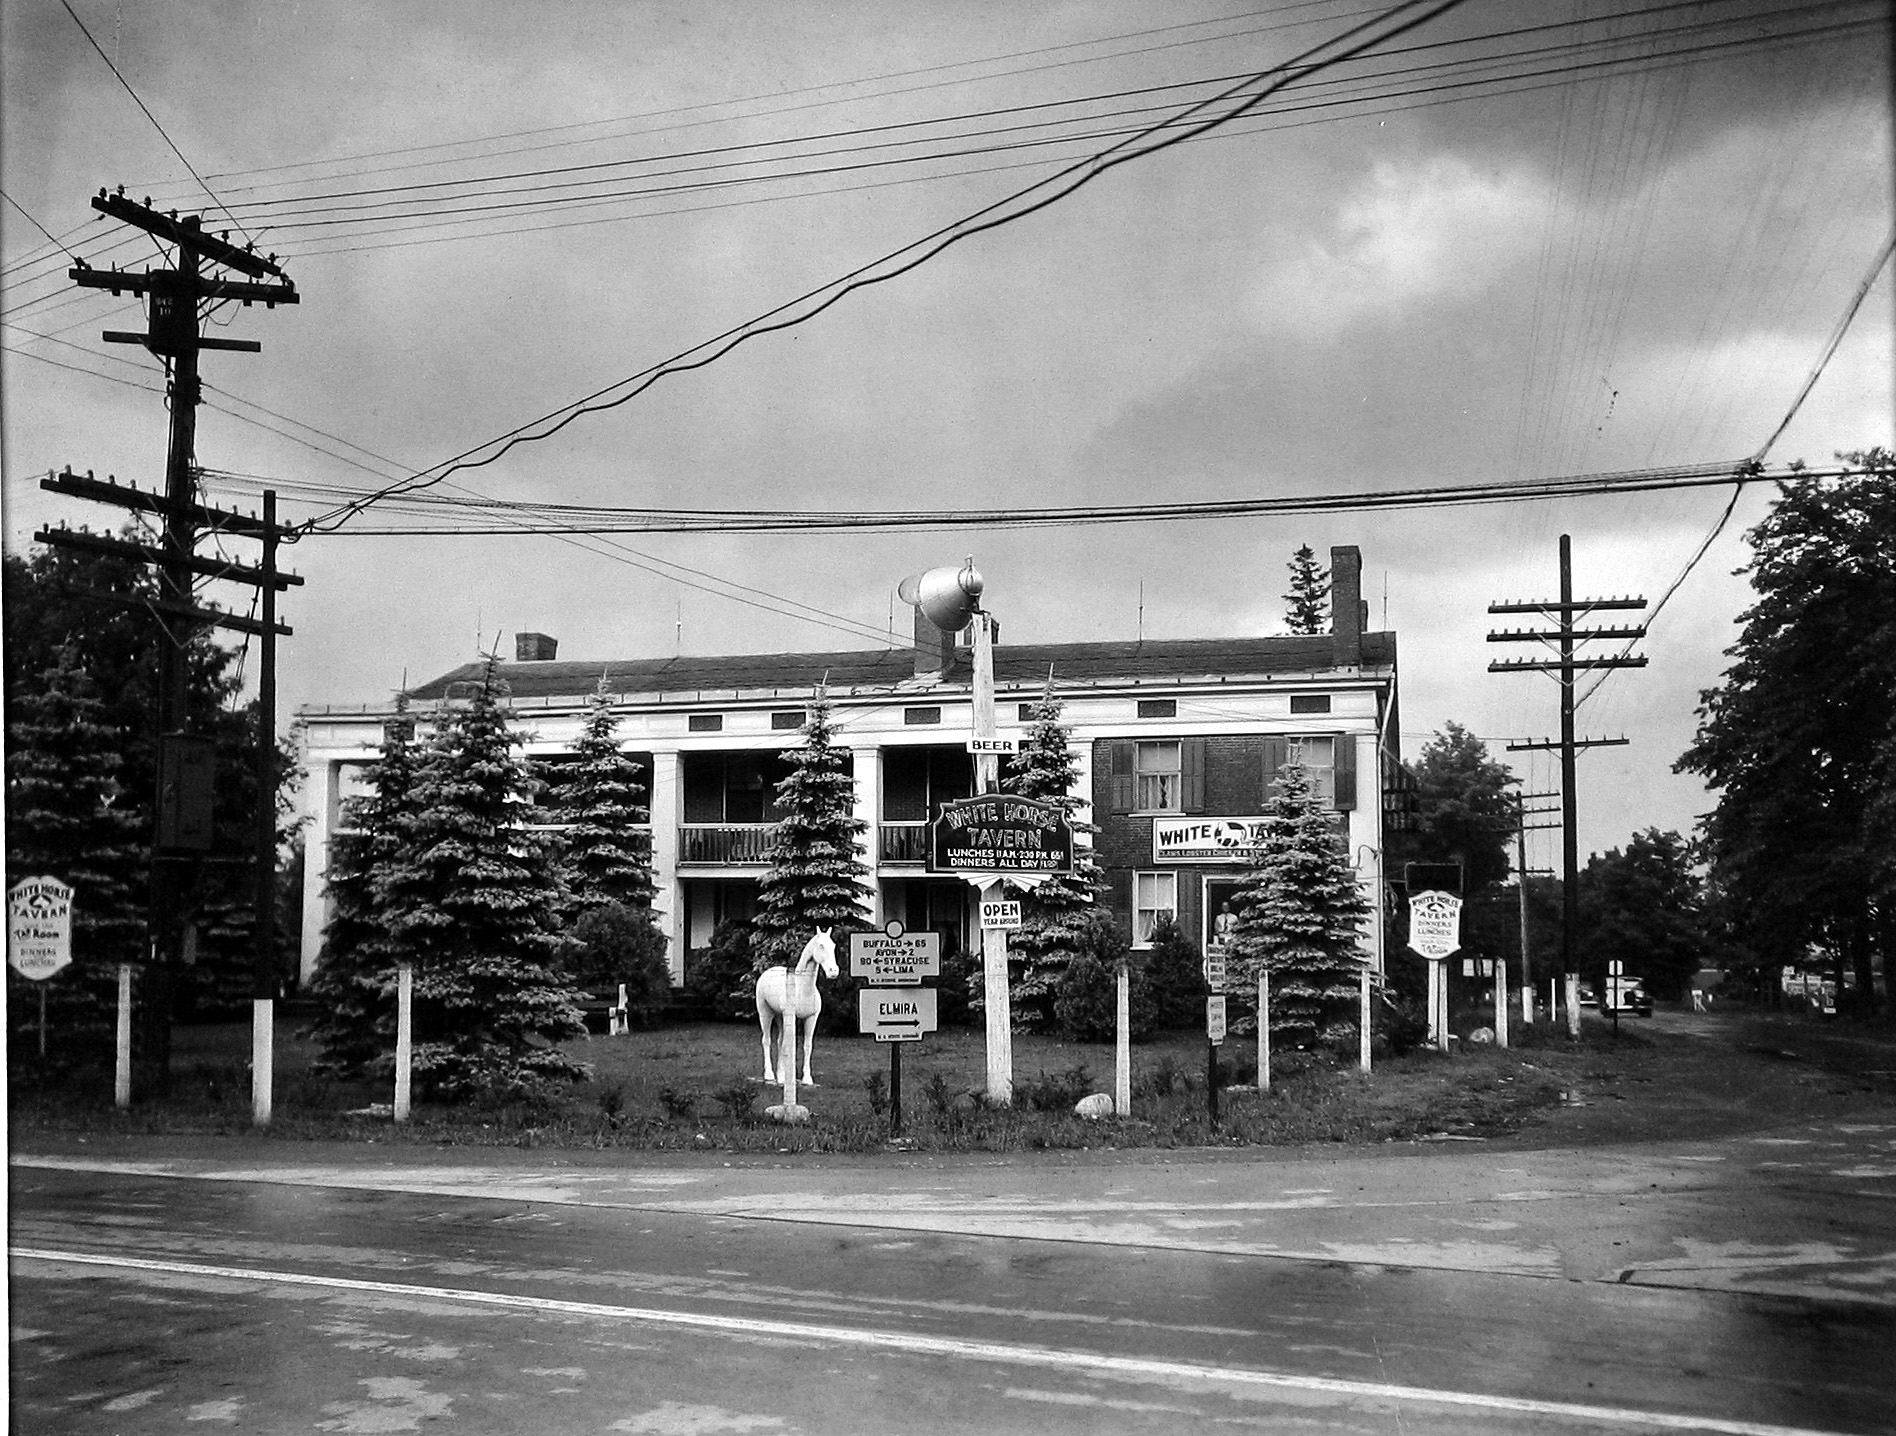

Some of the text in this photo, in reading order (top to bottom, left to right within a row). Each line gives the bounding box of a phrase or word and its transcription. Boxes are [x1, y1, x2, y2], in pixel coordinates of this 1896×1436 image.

[972, 740, 1013, 751] BEER
[945, 802, 1060, 832] WHITE HORSE
[966, 827, 1042, 849] TAVERN
[1159, 824, 1212, 847] WHITE
[947, 848, 995, 858] LUNCHES
[950, 857, 996, 867] DINNERS
[999, 859, 1019, 867] ALL
[1020, 859, 1039, 868] DAY
[9, 884, 70, 902] WHITE HORSE
[1411, 895, 1459, 908] WHITE HORSE
[13, 903, 67, 919] TAVERN
[983, 903, 1019, 917] OPEN
[1414, 908, 1456, 919] TAVERN
[1418, 920, 1452, 928] DINNERS
[1417, 928, 1452, 936] LUNCHES
[863, 939, 926, 949] BUFFALO 65
[875, 948, 915, 957] AVON 2
[883, 957, 931, 966] SYRACUSE
[875, 965, 915, 975] 5 LIMA
[879, 1002, 919, 1016] ELMIRA
